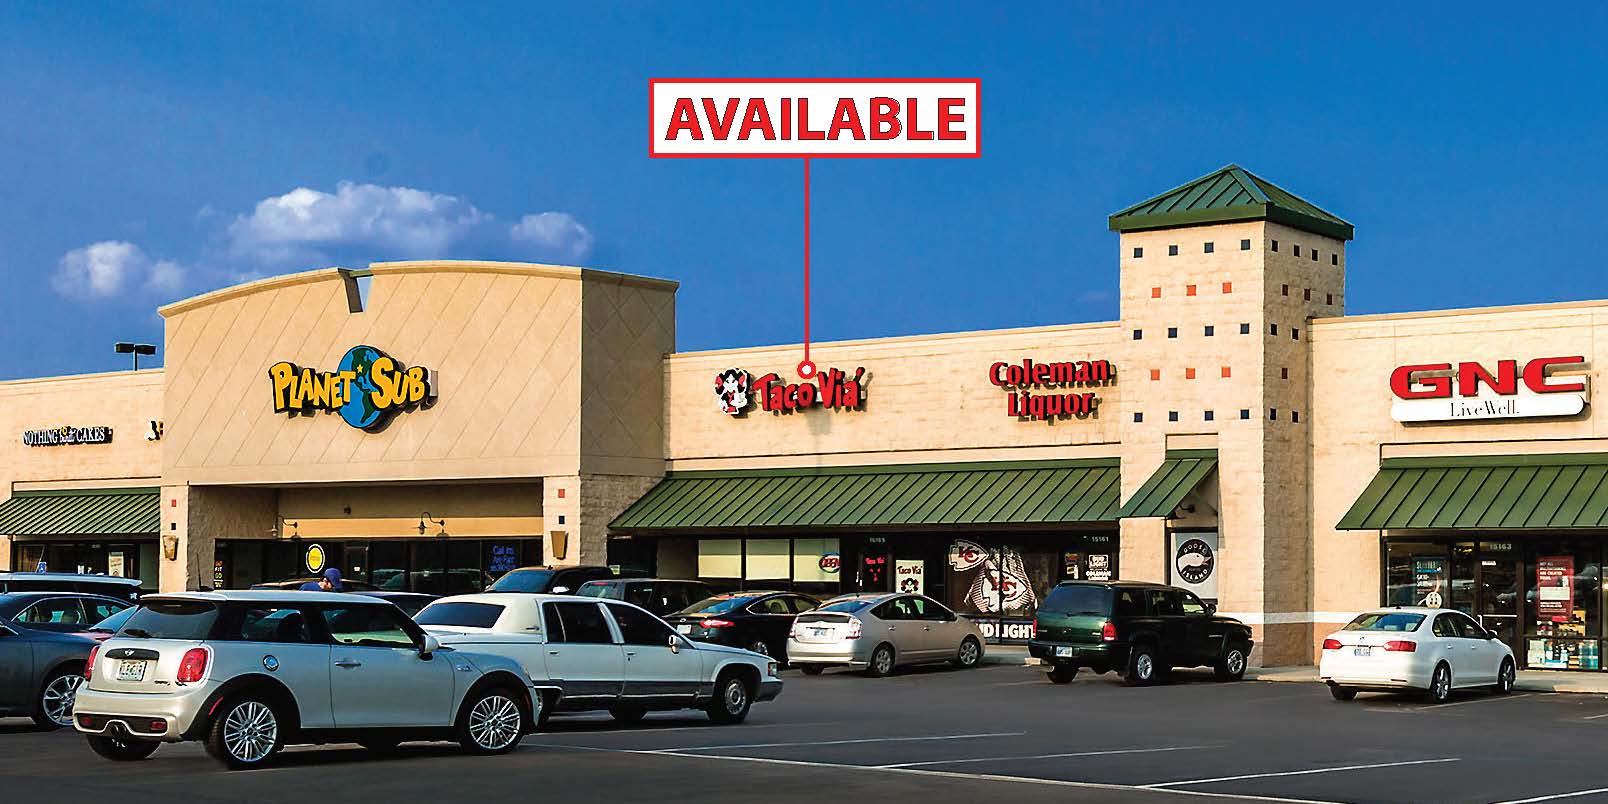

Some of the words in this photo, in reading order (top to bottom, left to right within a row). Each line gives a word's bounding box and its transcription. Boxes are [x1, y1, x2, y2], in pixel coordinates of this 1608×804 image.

[269, 361, 356, 411] PLANET
[370, 357, 427, 409] SUB
[989, 359, 1110, 386] Coleman
[1390, 356, 1584, 400] GNC
[752, 373, 817, 412] Taco
[1008, 391, 1096, 421] Liquor
[23, 430, 58, 445] NOTHING
[76, 427, 105, 442] CAKES
[1183, 543, 1207, 555] GOOSE
[897, 565, 911, 574] Taco
[1182, 568, 1208, 580] ISLAND
